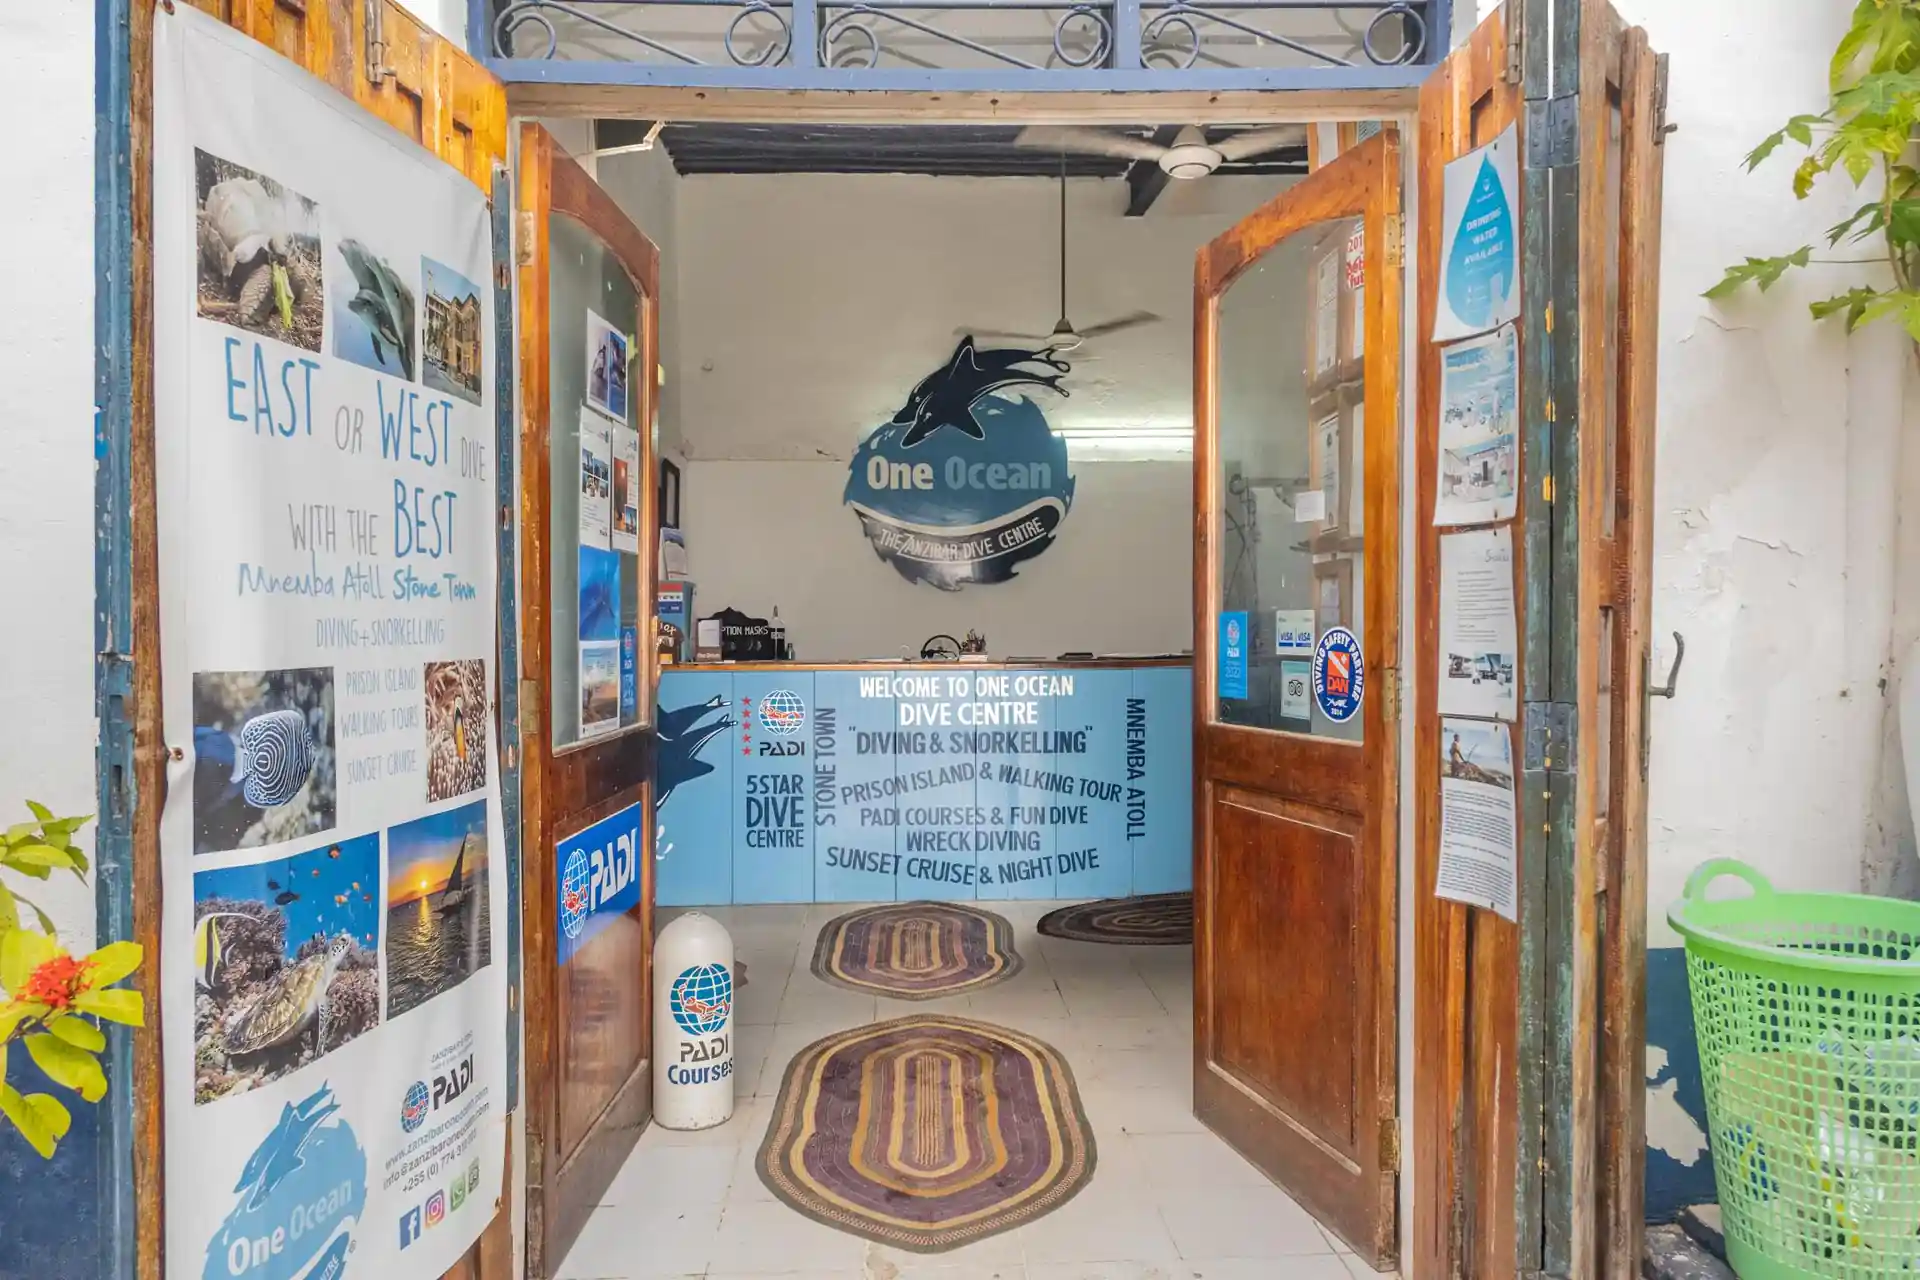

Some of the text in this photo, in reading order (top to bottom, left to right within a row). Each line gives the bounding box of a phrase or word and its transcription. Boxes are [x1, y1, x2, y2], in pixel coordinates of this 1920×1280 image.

[225, 336, 486, 482] EAST OR WEST DIVE
[867, 455, 1052, 490] One Ocean
[288, 478, 457, 558] WITH THE BEST
[880, 528, 903, 551] THE
[962, 537, 994, 559] DIVE
[998, 516, 1045, 548] CENTRE
[238, 551, 335, 598] Mnemba
[342, 561, 385, 600] Atoll
[393, 564, 441, 601] Stone
[744, 625, 769, 636] MASKS
[346, 666, 417, 697] PRISON ISLAND
[1314, 632, 1364, 702] DIVING SAFETY PARTNER
[860, 675, 1074, 698] WELCOME TO ONE OCEAN
[1327, 677, 1349, 694] DAN
[900, 701, 1038, 726] DIVE CENTRE
[759, 741, 806, 757] PADI
[929, 732, 945, 753] &
[815, 707, 836, 827] STONE TOWN
[841, 761, 1123, 805] PRISON ISLAND & WALKING TOUR
[1127, 698, 1146, 841] MNEMBA ATOLL
[746, 796, 804, 828] DIVE
[860, 805, 1089, 827] PADI COURSES & FUN DIVE
[746, 829, 804, 848] CENTRE
[906, 830, 1041, 852] WRECK DIVING
[590, 826, 638, 911] PADI
[825, 846, 1100, 886] SUNSET CRUISE & NIGHT DIVE
[680, 1033, 729, 1063] PADI
[433, 1052, 473, 1112] PADI
[667, 1057, 734, 1086] Courses
[228, 1180, 353, 1276] One Ocean
